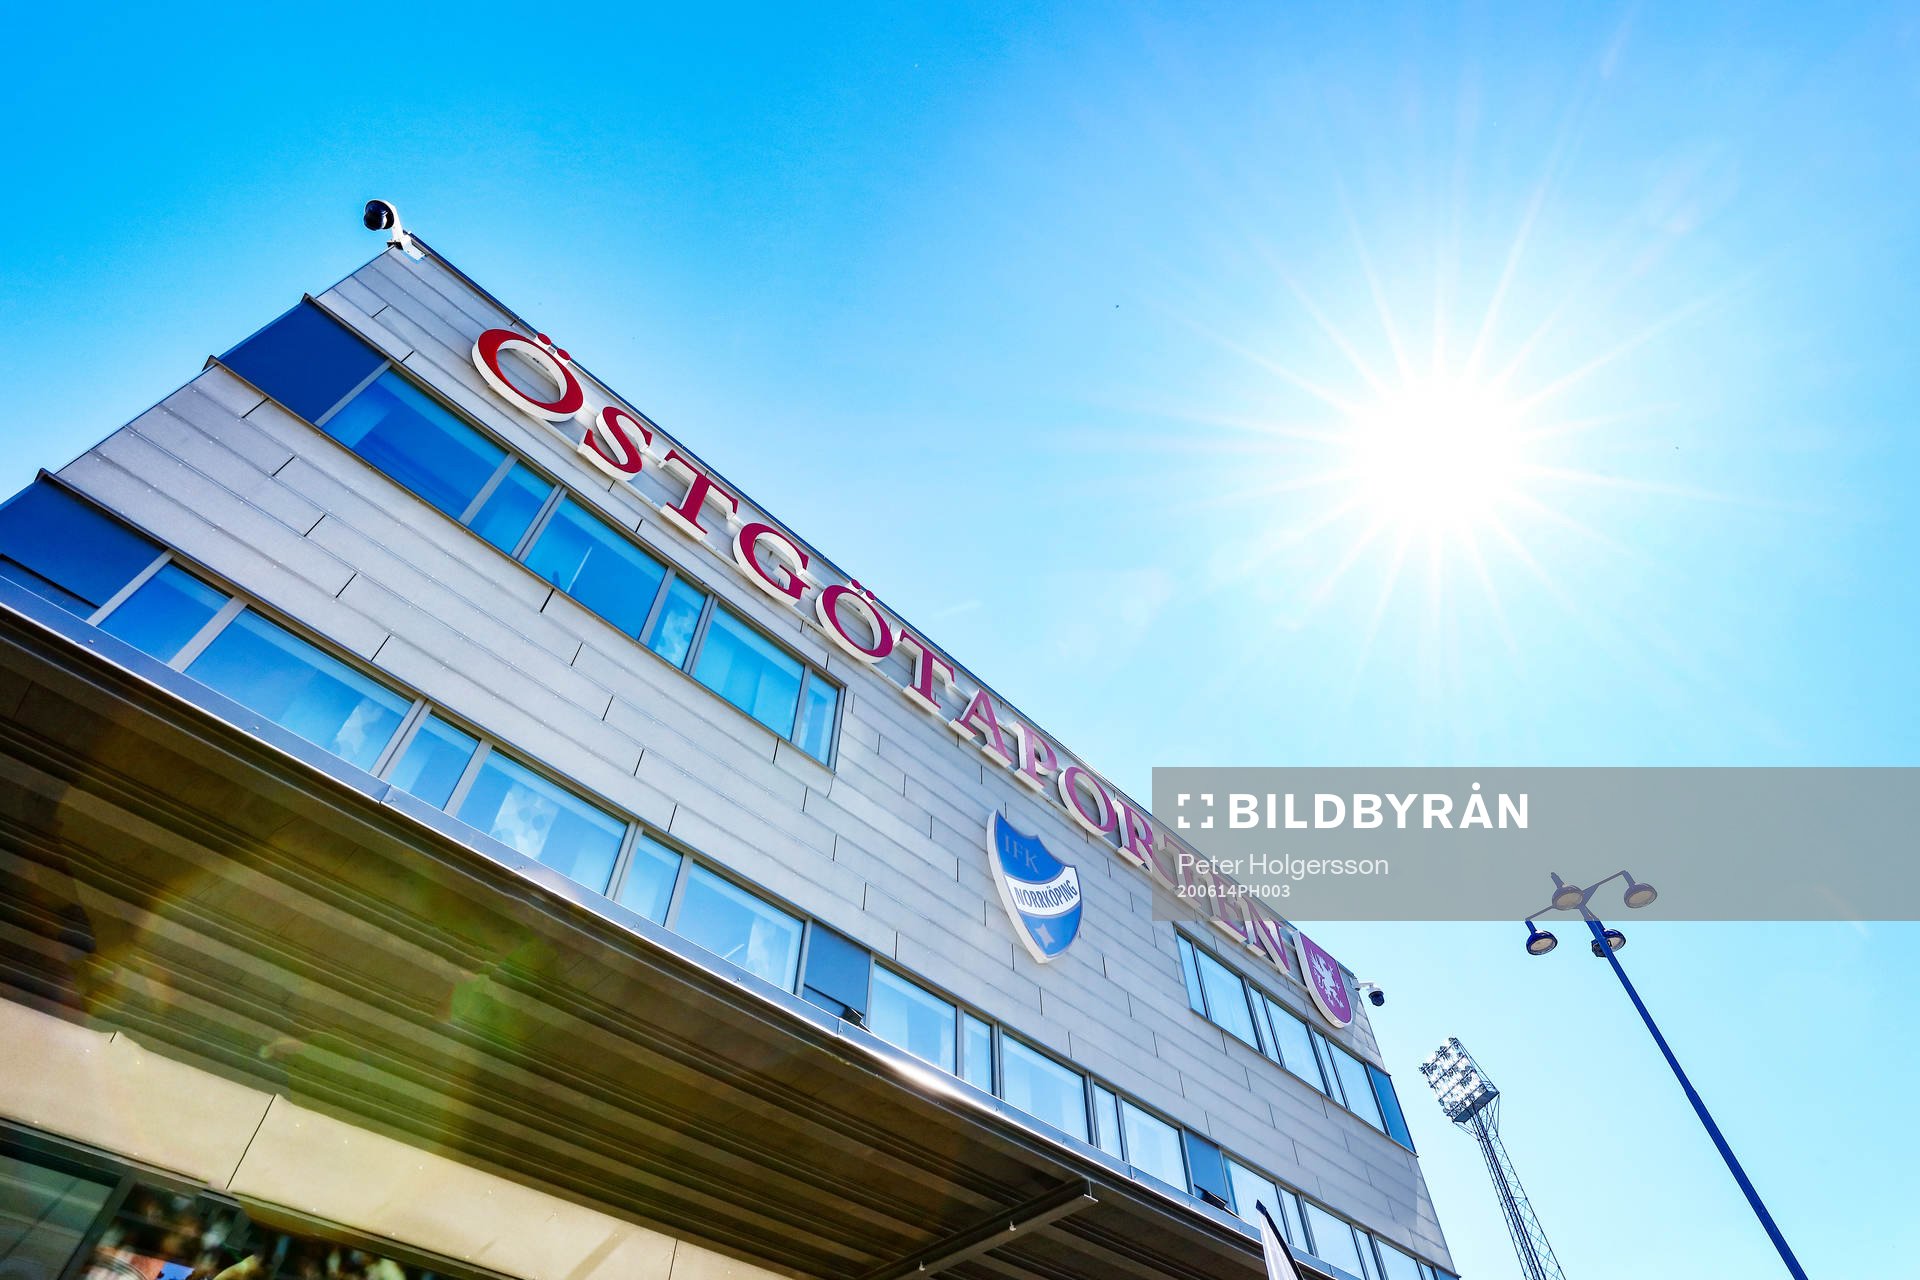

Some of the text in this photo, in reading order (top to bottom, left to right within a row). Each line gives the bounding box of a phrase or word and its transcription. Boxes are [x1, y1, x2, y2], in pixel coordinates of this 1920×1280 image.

[472, 328, 1292, 975] ÖSTGÖTAPORTEN
[1005, 835, 1039, 874] IFK
[1014, 879, 1078, 909] NORRKÖPING
